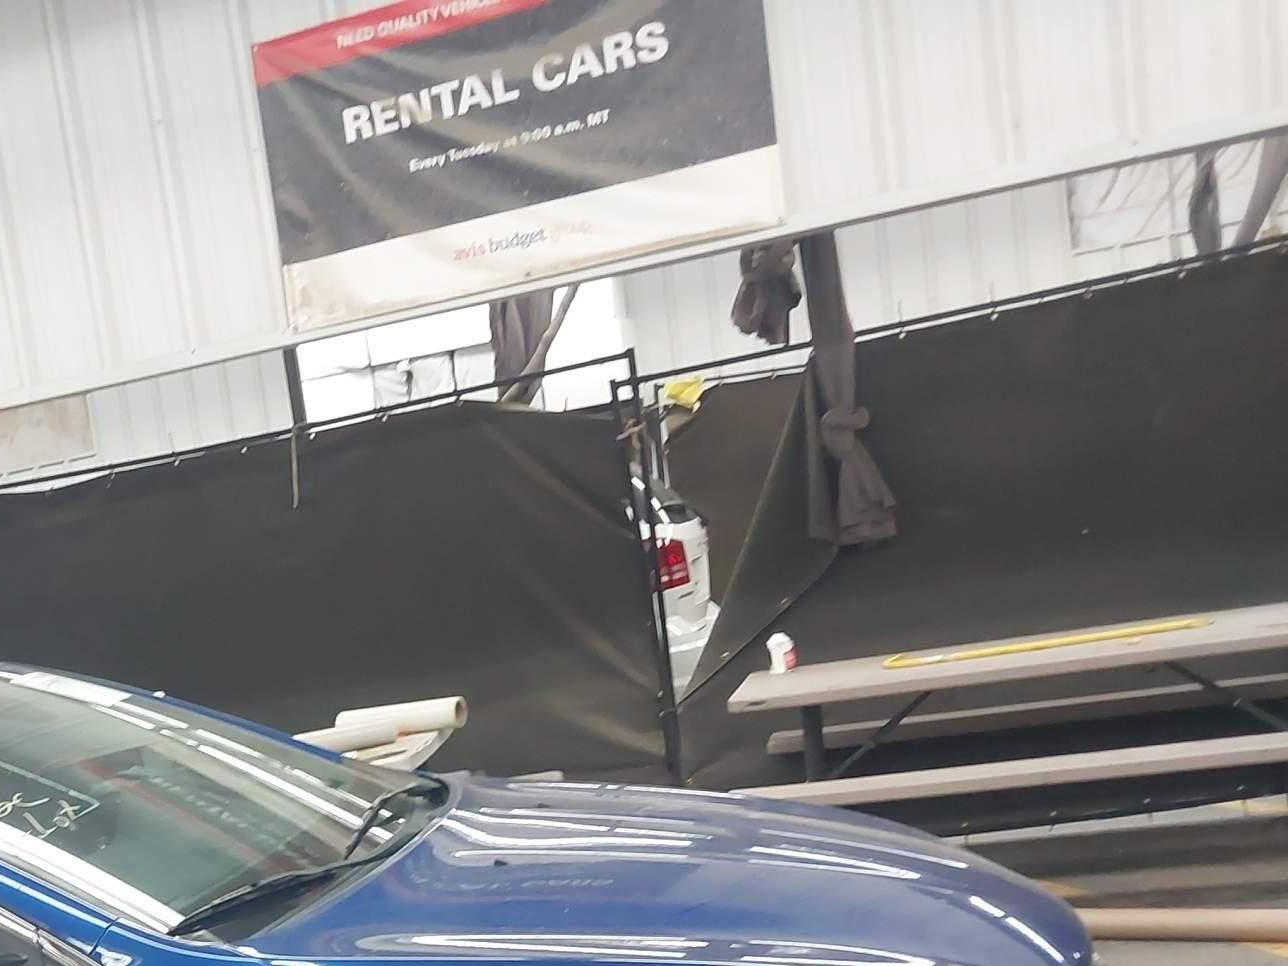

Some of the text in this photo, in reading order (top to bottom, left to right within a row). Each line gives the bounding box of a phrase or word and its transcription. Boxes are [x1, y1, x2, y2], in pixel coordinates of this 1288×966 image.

[336, 26, 374, 49] NEED
[377, 6, 439, 38] QUALITY
[342, 21, 669, 145] RENTAL CARS
[408, 153, 446, 174] Every
[447, 139, 501, 163] Tuesday
[586, 108, 611, 129] MT
[487, 227, 548, 254] budget
